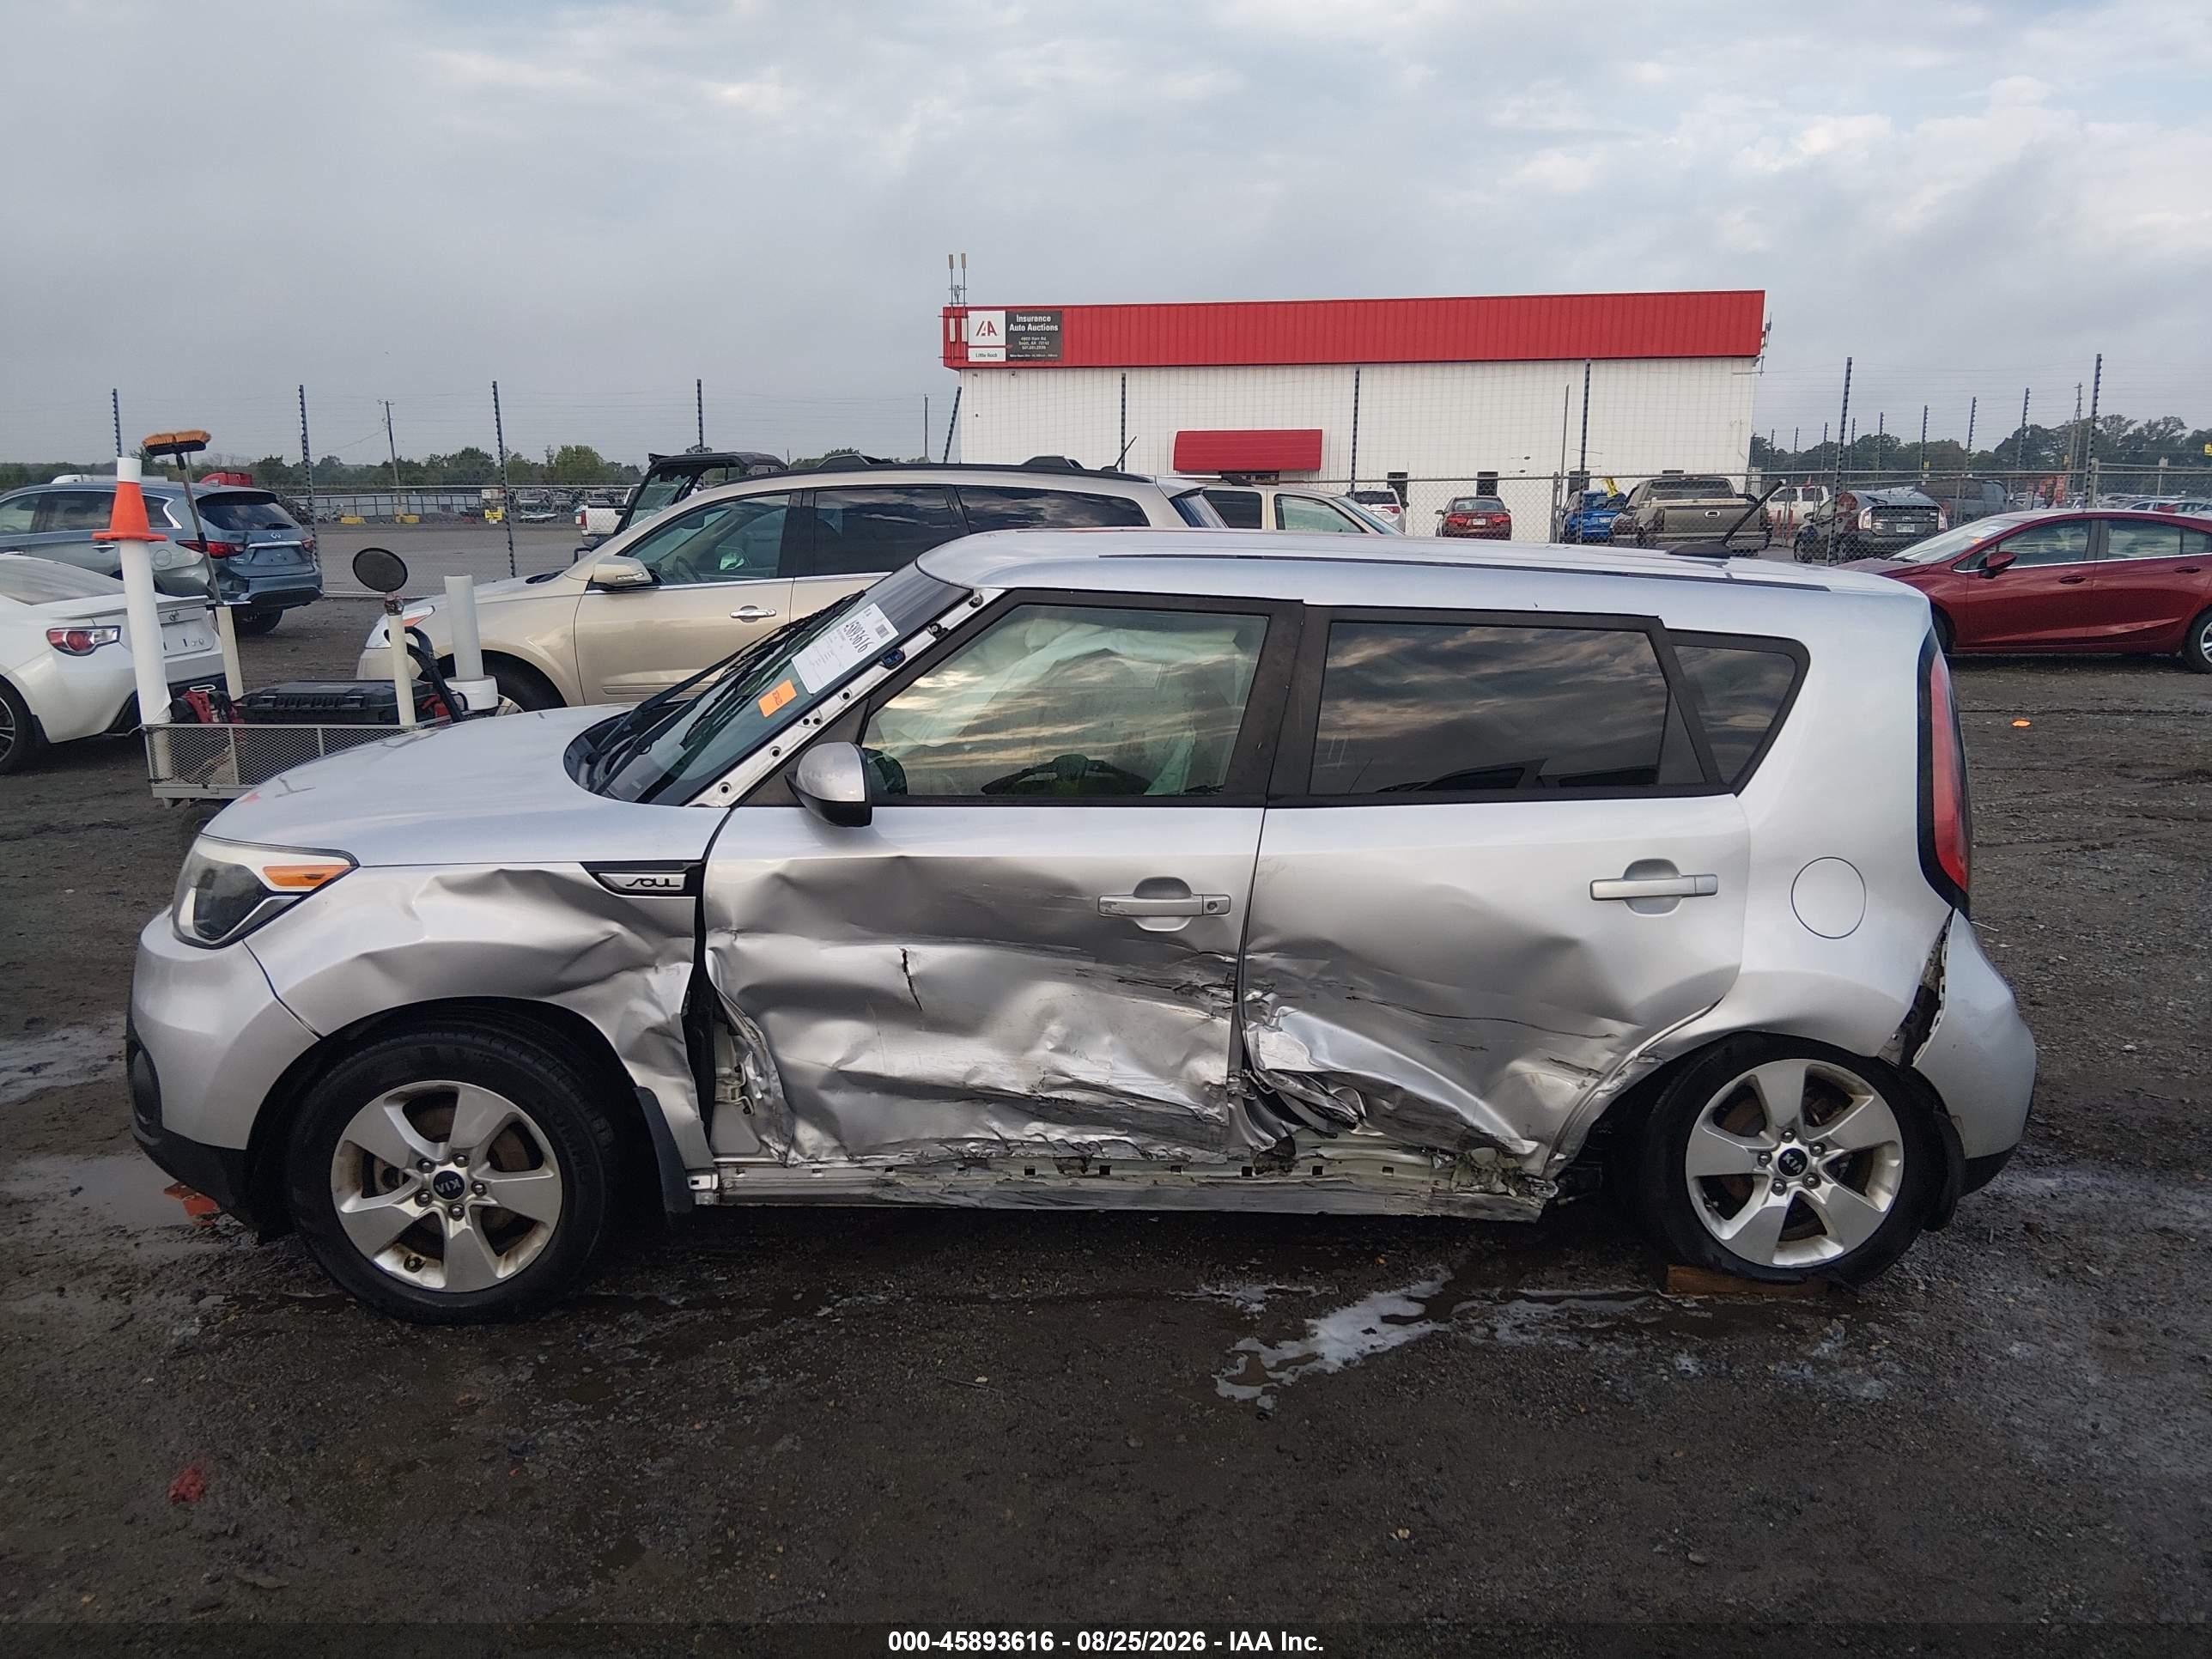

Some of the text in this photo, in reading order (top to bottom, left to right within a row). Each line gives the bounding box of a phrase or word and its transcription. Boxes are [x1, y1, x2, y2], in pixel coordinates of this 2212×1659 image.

[1016, 314, 1051, 323] Insurance
[1027, 323, 1059, 331] Auctions
[625, 878, 681, 888] SOUL
[1783, 1153, 1802, 1173] KIA
[434, 1178, 461, 1194] KIA
